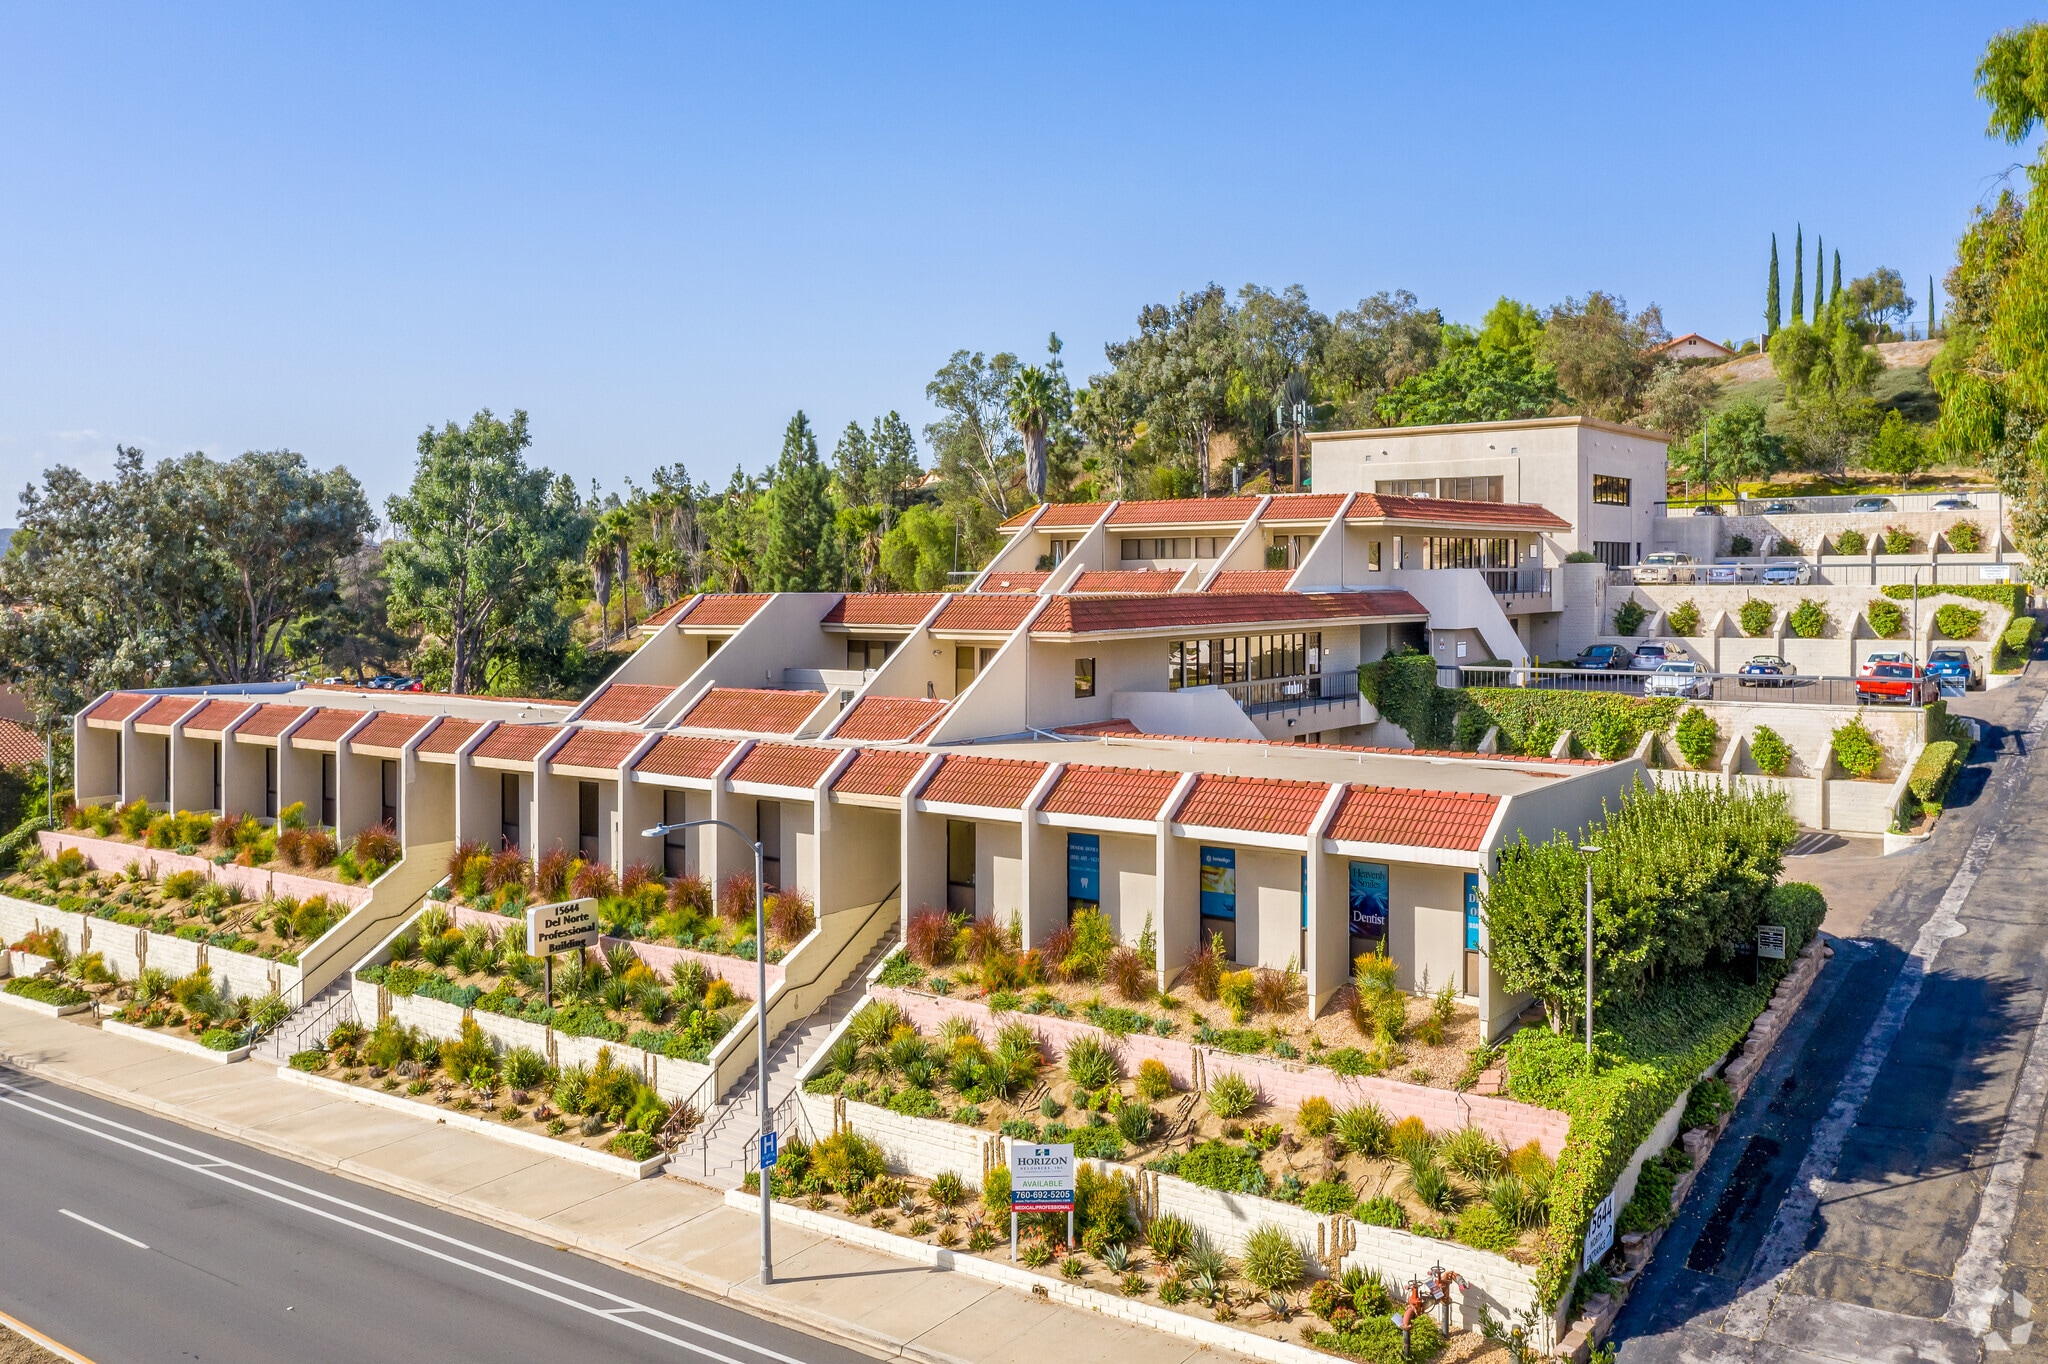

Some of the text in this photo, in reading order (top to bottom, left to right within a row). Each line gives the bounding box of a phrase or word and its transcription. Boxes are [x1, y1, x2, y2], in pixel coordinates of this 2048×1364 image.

[1353, 867, 1386, 882] Heavenly
[1357, 878, 1382, 889] Smiles
[555, 903, 579, 916] 15644
[545, 913, 590, 928] Del Norte
[1353, 910, 1386, 925] Dentist
[538, 922, 596, 942] Professional
[548, 939, 587, 953] Building
[764, 1134, 774, 1154] H
[1017, 1156, 1068, 1166] HORIZON
[1022, 1180, 1063, 1188] AVAILABLE
[1015, 1190, 1071, 1199] 760-692-5205
[1590, 1230, 1604, 1249] NORTH
[1586, 1239, 1607, 1266] ENTRANCE
